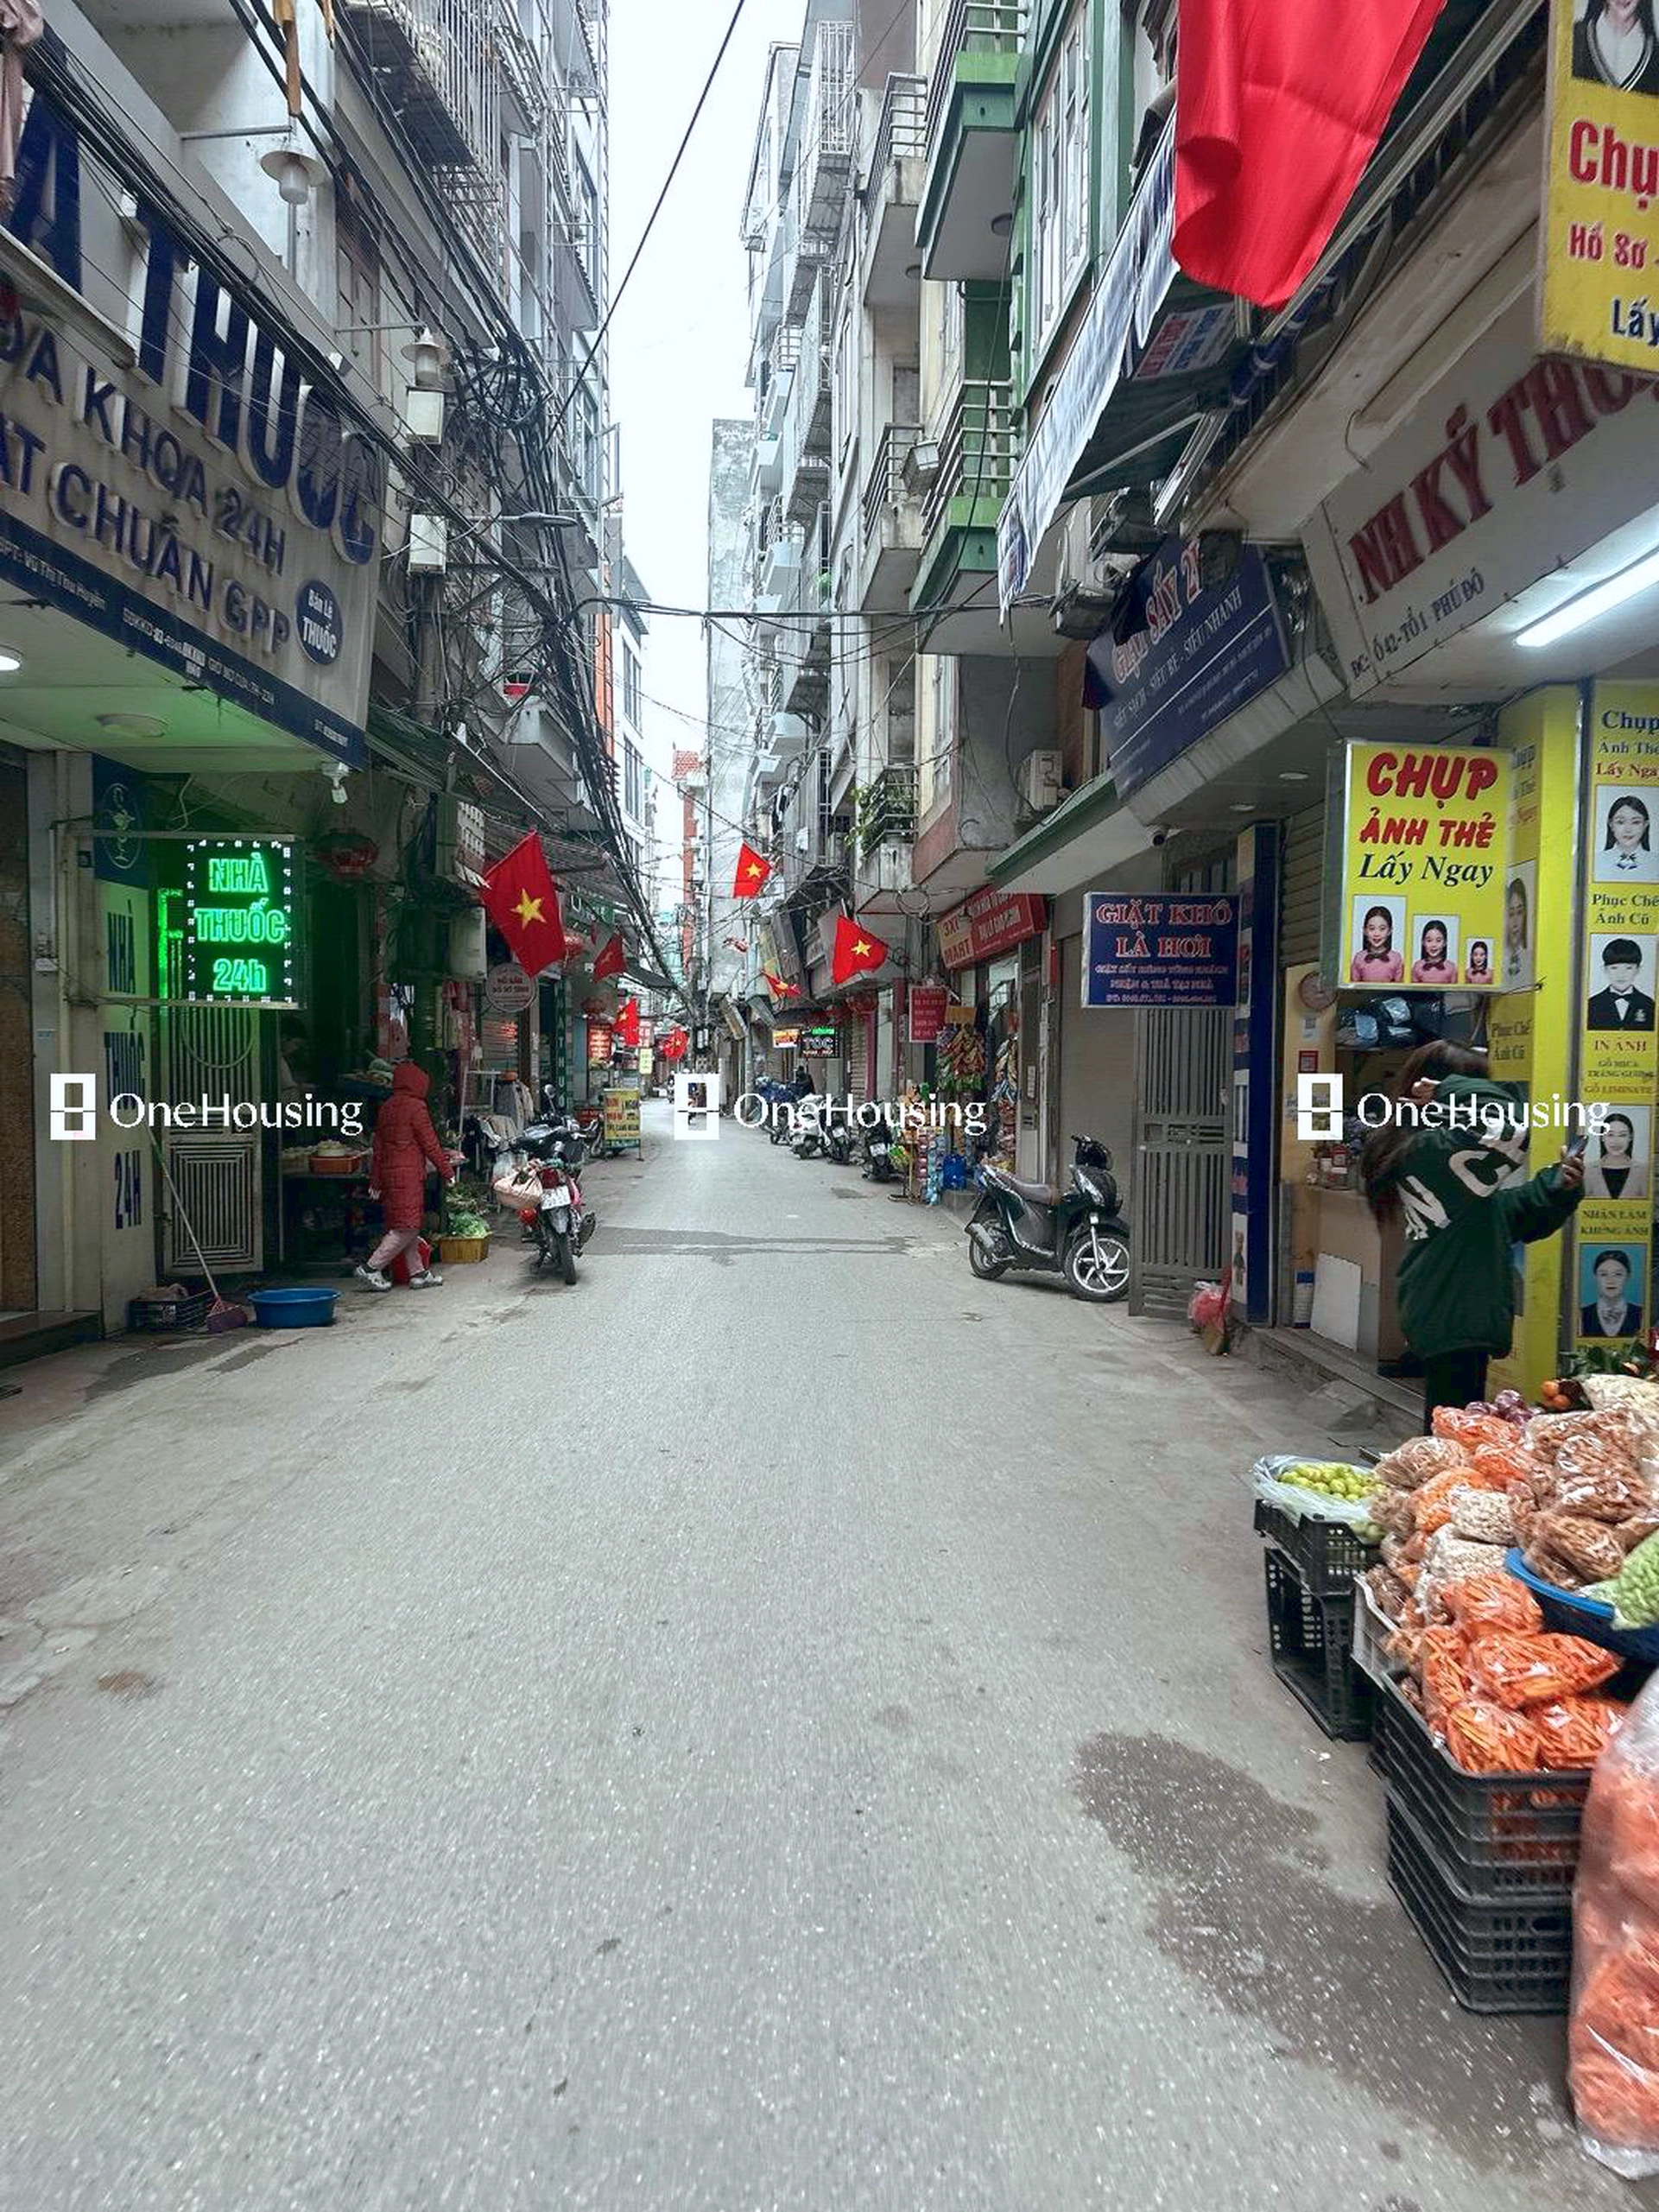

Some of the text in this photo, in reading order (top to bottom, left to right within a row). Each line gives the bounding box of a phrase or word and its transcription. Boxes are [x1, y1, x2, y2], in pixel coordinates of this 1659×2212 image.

[1204, 584, 1243, 634] NHANH
[1366, 751, 1499, 809] CHỤP
[1596, 760, 1623, 778] Lấy
[1358, 806, 1497, 849] ẢNH THẺ
[209, 852, 269, 893] NHÀ
[1358, 850, 1494, 889] Lấy Ngay
[193, 897, 286, 944] THUỐC
[1096, 898, 1232, 930] GIẶT KHÔ
[1115, 930, 1212, 958] LÀ HƠI
[212, 958, 268, 992] 24h
